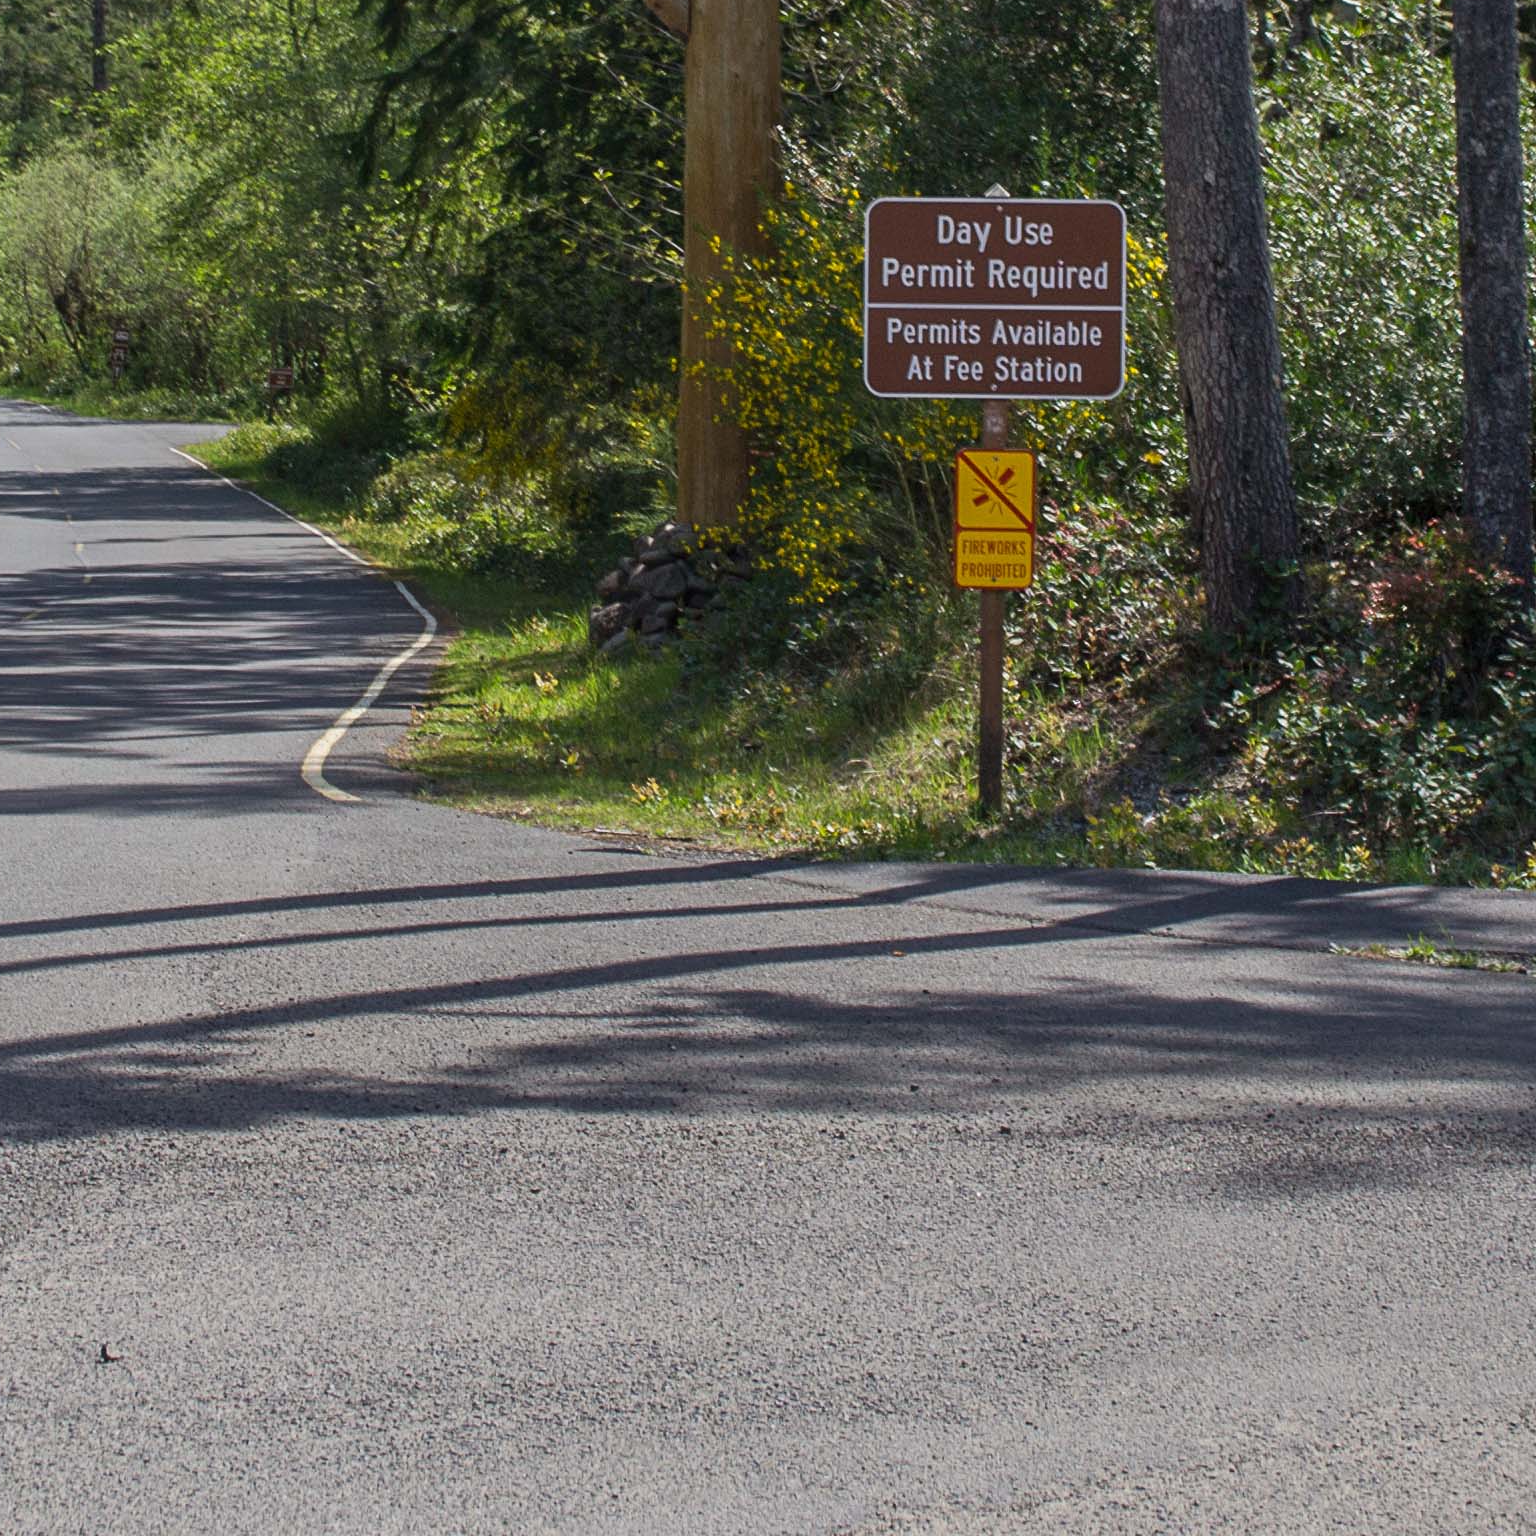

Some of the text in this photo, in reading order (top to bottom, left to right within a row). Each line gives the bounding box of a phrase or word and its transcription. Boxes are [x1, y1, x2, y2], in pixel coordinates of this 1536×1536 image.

[937, 215, 1053, 252] Day Use
[881, 257, 1109, 298] Permit Required
[886, 317, 1103, 347] Permits Available
[907, 355, 1083, 383] At Fee Station
[962, 540, 1026, 556] FIREWORKS
[961, 562, 1027, 578] PROHIBITED
